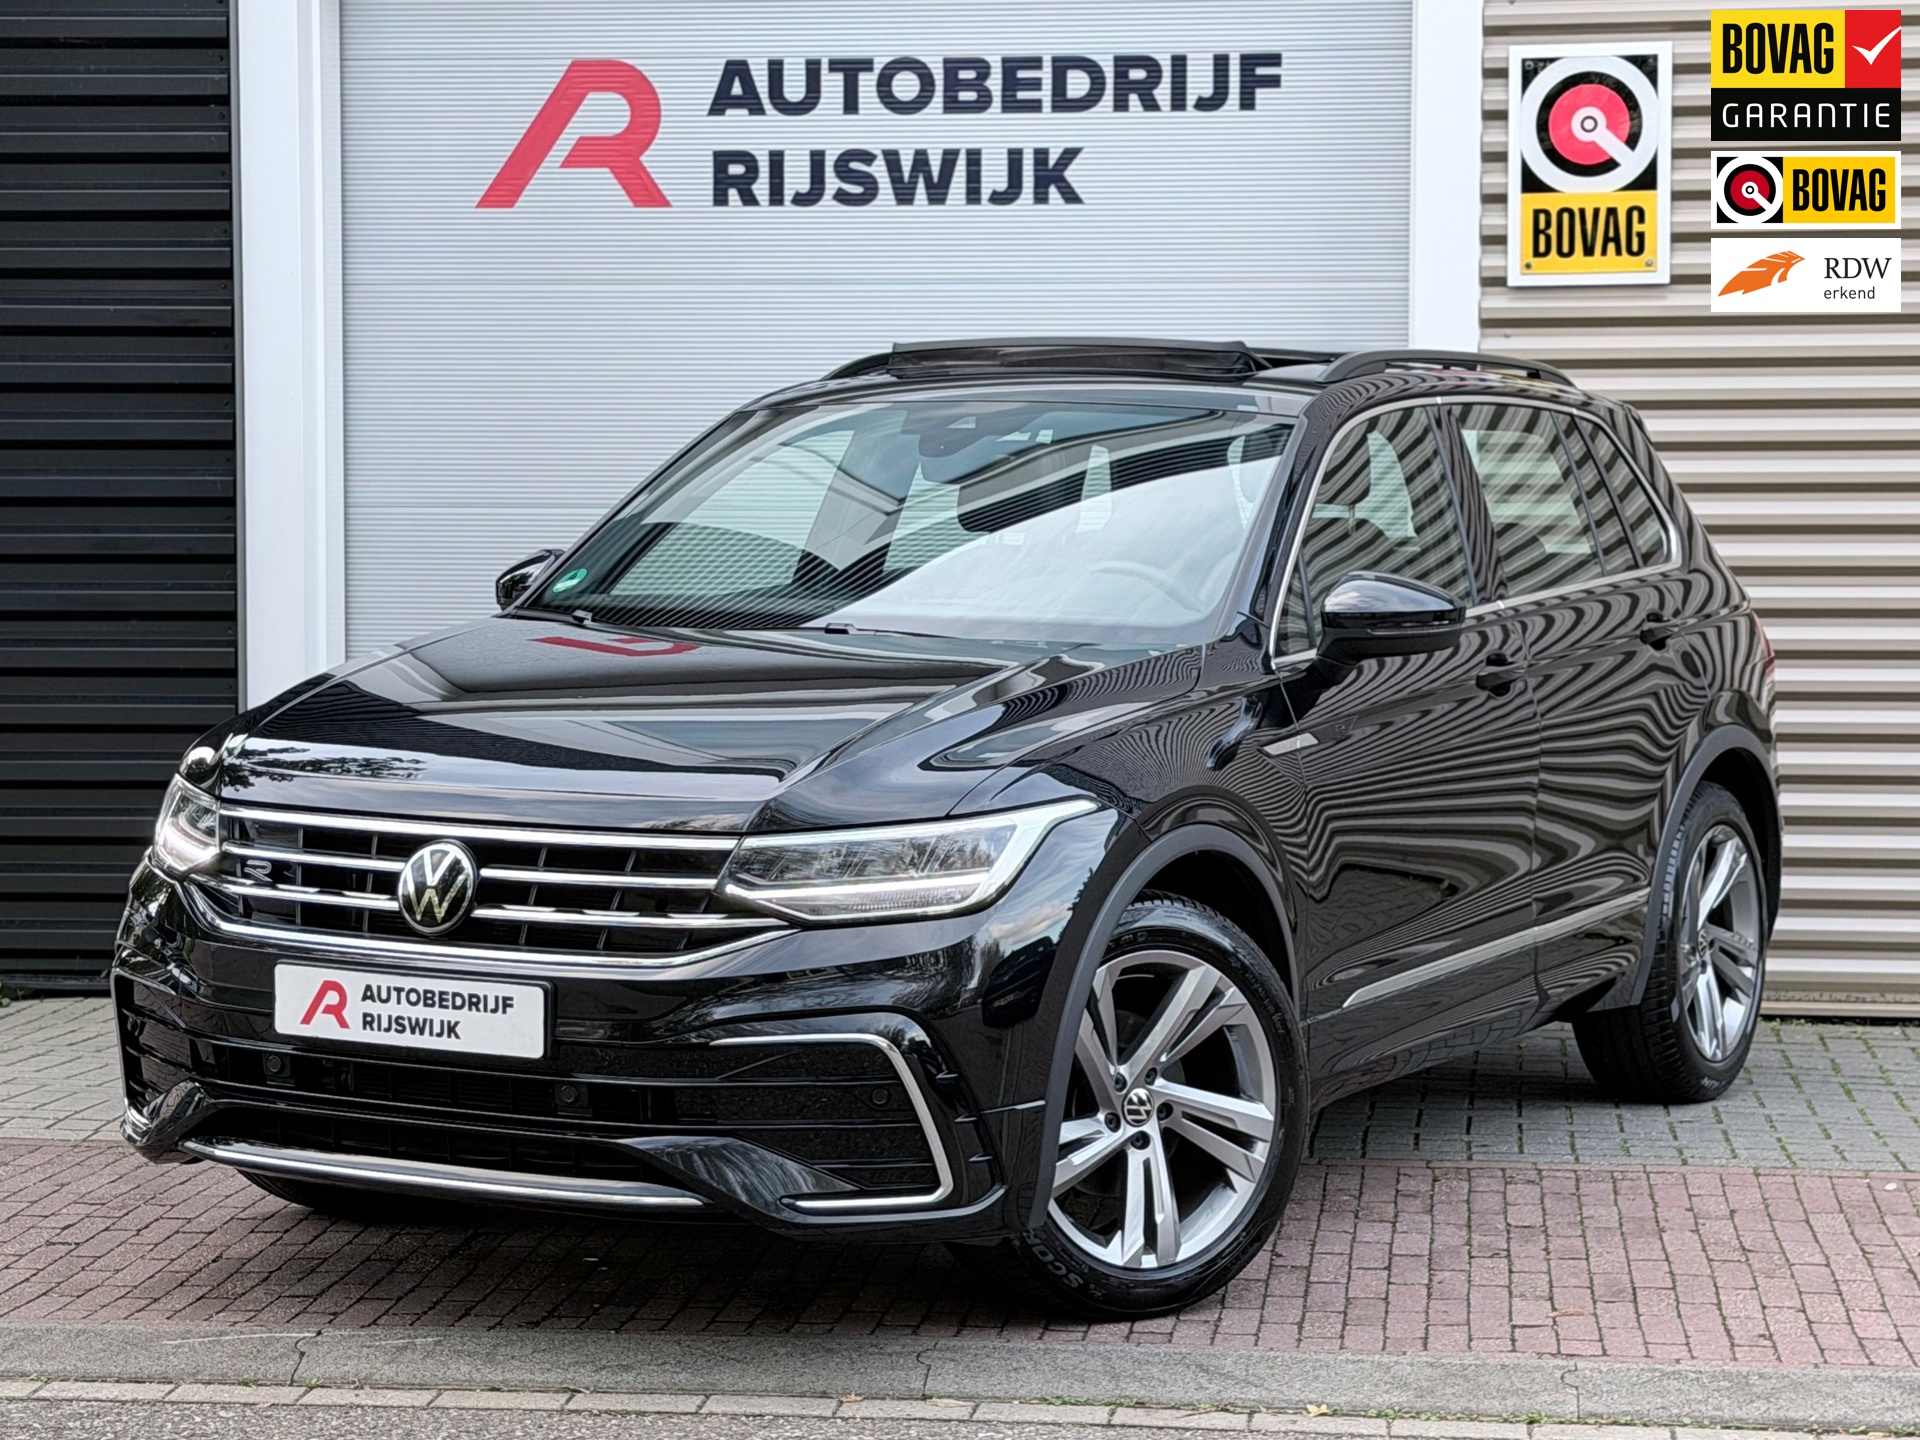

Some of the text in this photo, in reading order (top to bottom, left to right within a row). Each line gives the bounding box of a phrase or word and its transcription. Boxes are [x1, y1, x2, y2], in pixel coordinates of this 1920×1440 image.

[707, 53, 1283, 116] AUTOBEDRIJF
[712, 147, 1084, 207] RIJSWIJK
[1532, 205, 1646, 259] BOVAG
[361, 983, 514, 1014] AUTOBEDRIJF
[362, 1012, 461, 1040] RIJSWIJK
